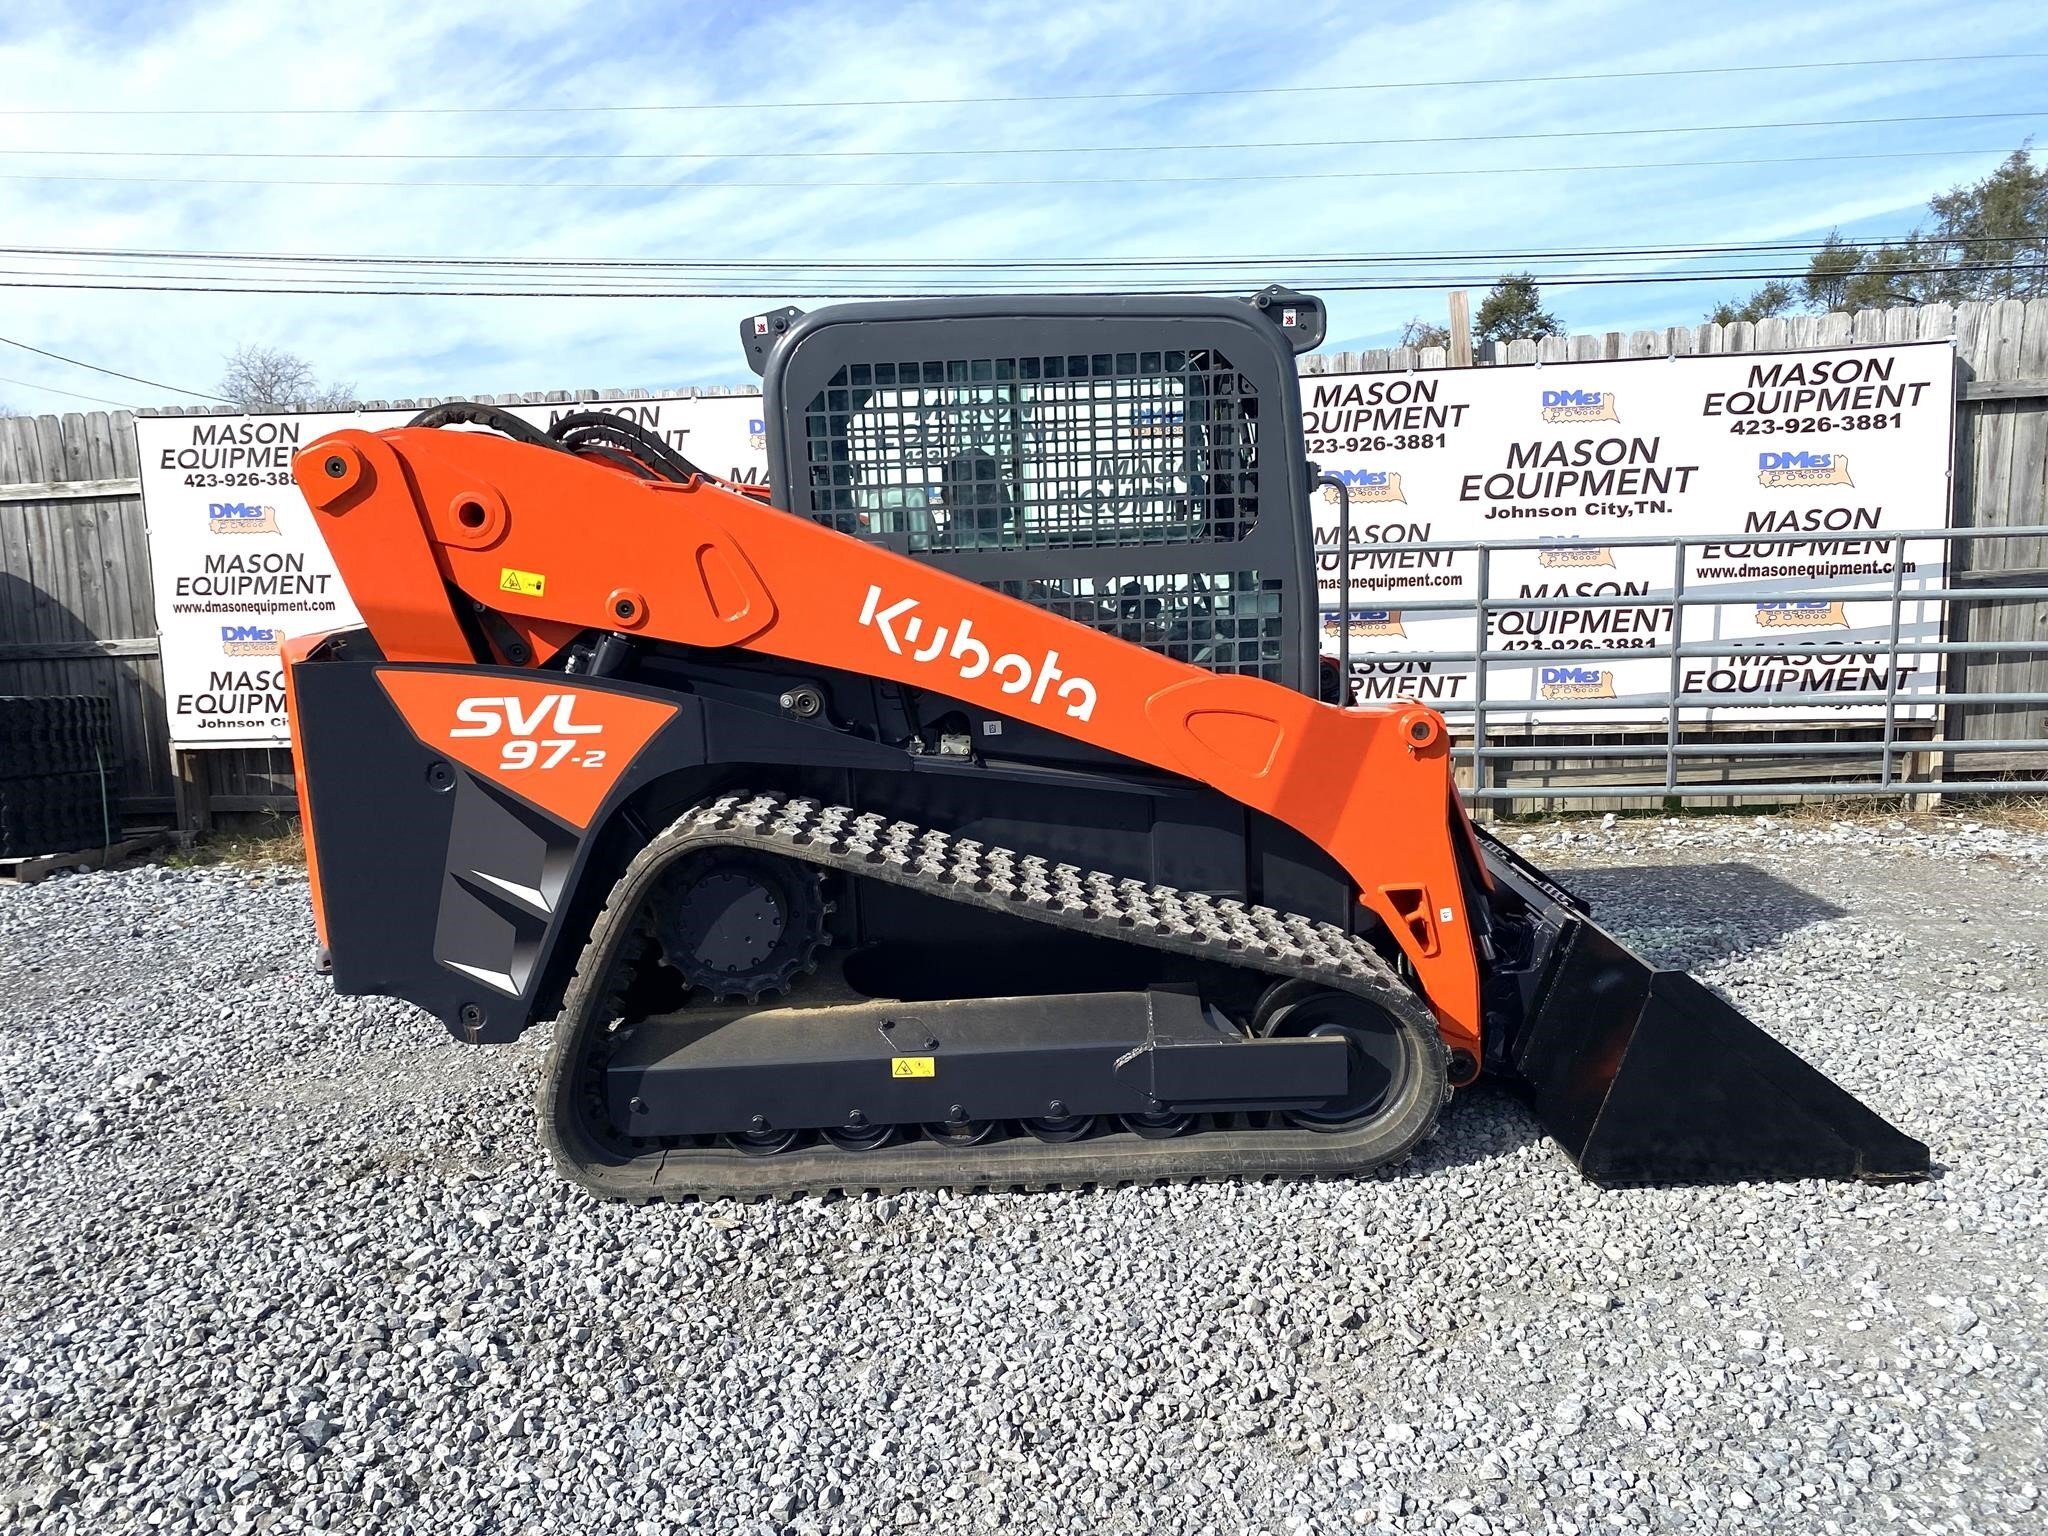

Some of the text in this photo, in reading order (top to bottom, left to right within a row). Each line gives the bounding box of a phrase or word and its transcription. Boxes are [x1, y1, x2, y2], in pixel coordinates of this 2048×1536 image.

[1748, 357, 1895, 388] MASON
[1313, 380, 1439, 408] MASON
[1703, 382, 1931, 416] EQUIPMENT
[193, 422, 300, 446] MASON
[1730, 412, 1902, 435] 423-926-3881
[1506, 437, 1660, 470] MASON
[1459, 466, 1699, 502] EQUIPMENT
[1485, 503, 1577, 520] Johnson
[1745, 507, 1882, 533] MASON
[1314, 523, 1431, 544] MASON
[205, 553, 304, 574] MASON
[1696, 560, 1916, 580] www.dmasonequipment.cm
[176, 574, 331, 596] EQUIPMENT
[173, 599, 336, 615] www.dmasonequipment.com
[858, 584, 1098, 722] Kubota
[1682, 666, 1918, 694] EQUIPMENT
[197, 718, 265, 729] Johnson
[449, 694, 604, 738] SVL
[499, 739, 607, 770] 97-2
